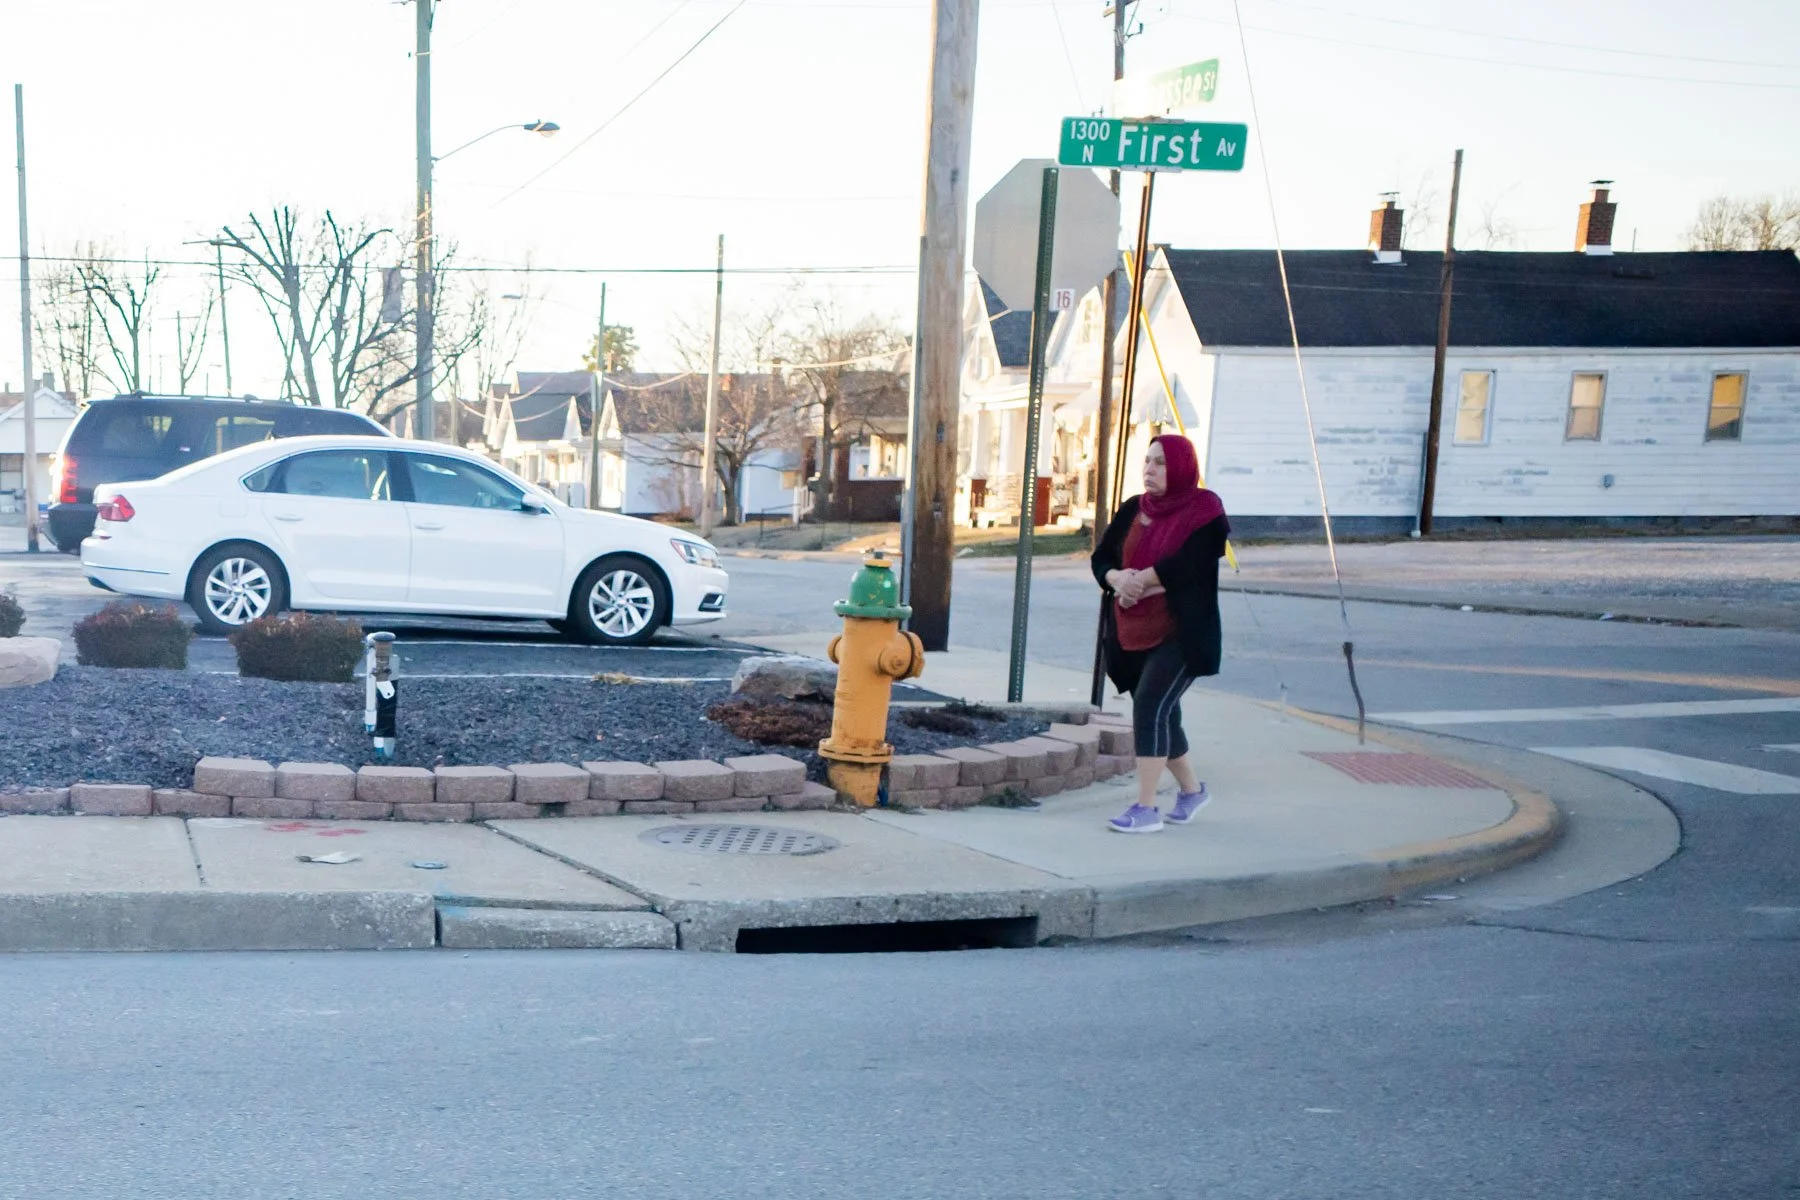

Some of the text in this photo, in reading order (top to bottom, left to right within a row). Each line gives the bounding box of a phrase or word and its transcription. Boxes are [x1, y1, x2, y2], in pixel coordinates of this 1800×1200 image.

[1203, 71, 1215, 91] St
[1070, 120, 1111, 141] 1300
[1082, 144, 1094, 163] N
[1117, 125, 1236, 165] First Av
[1057, 291, 1071, 308] 16
